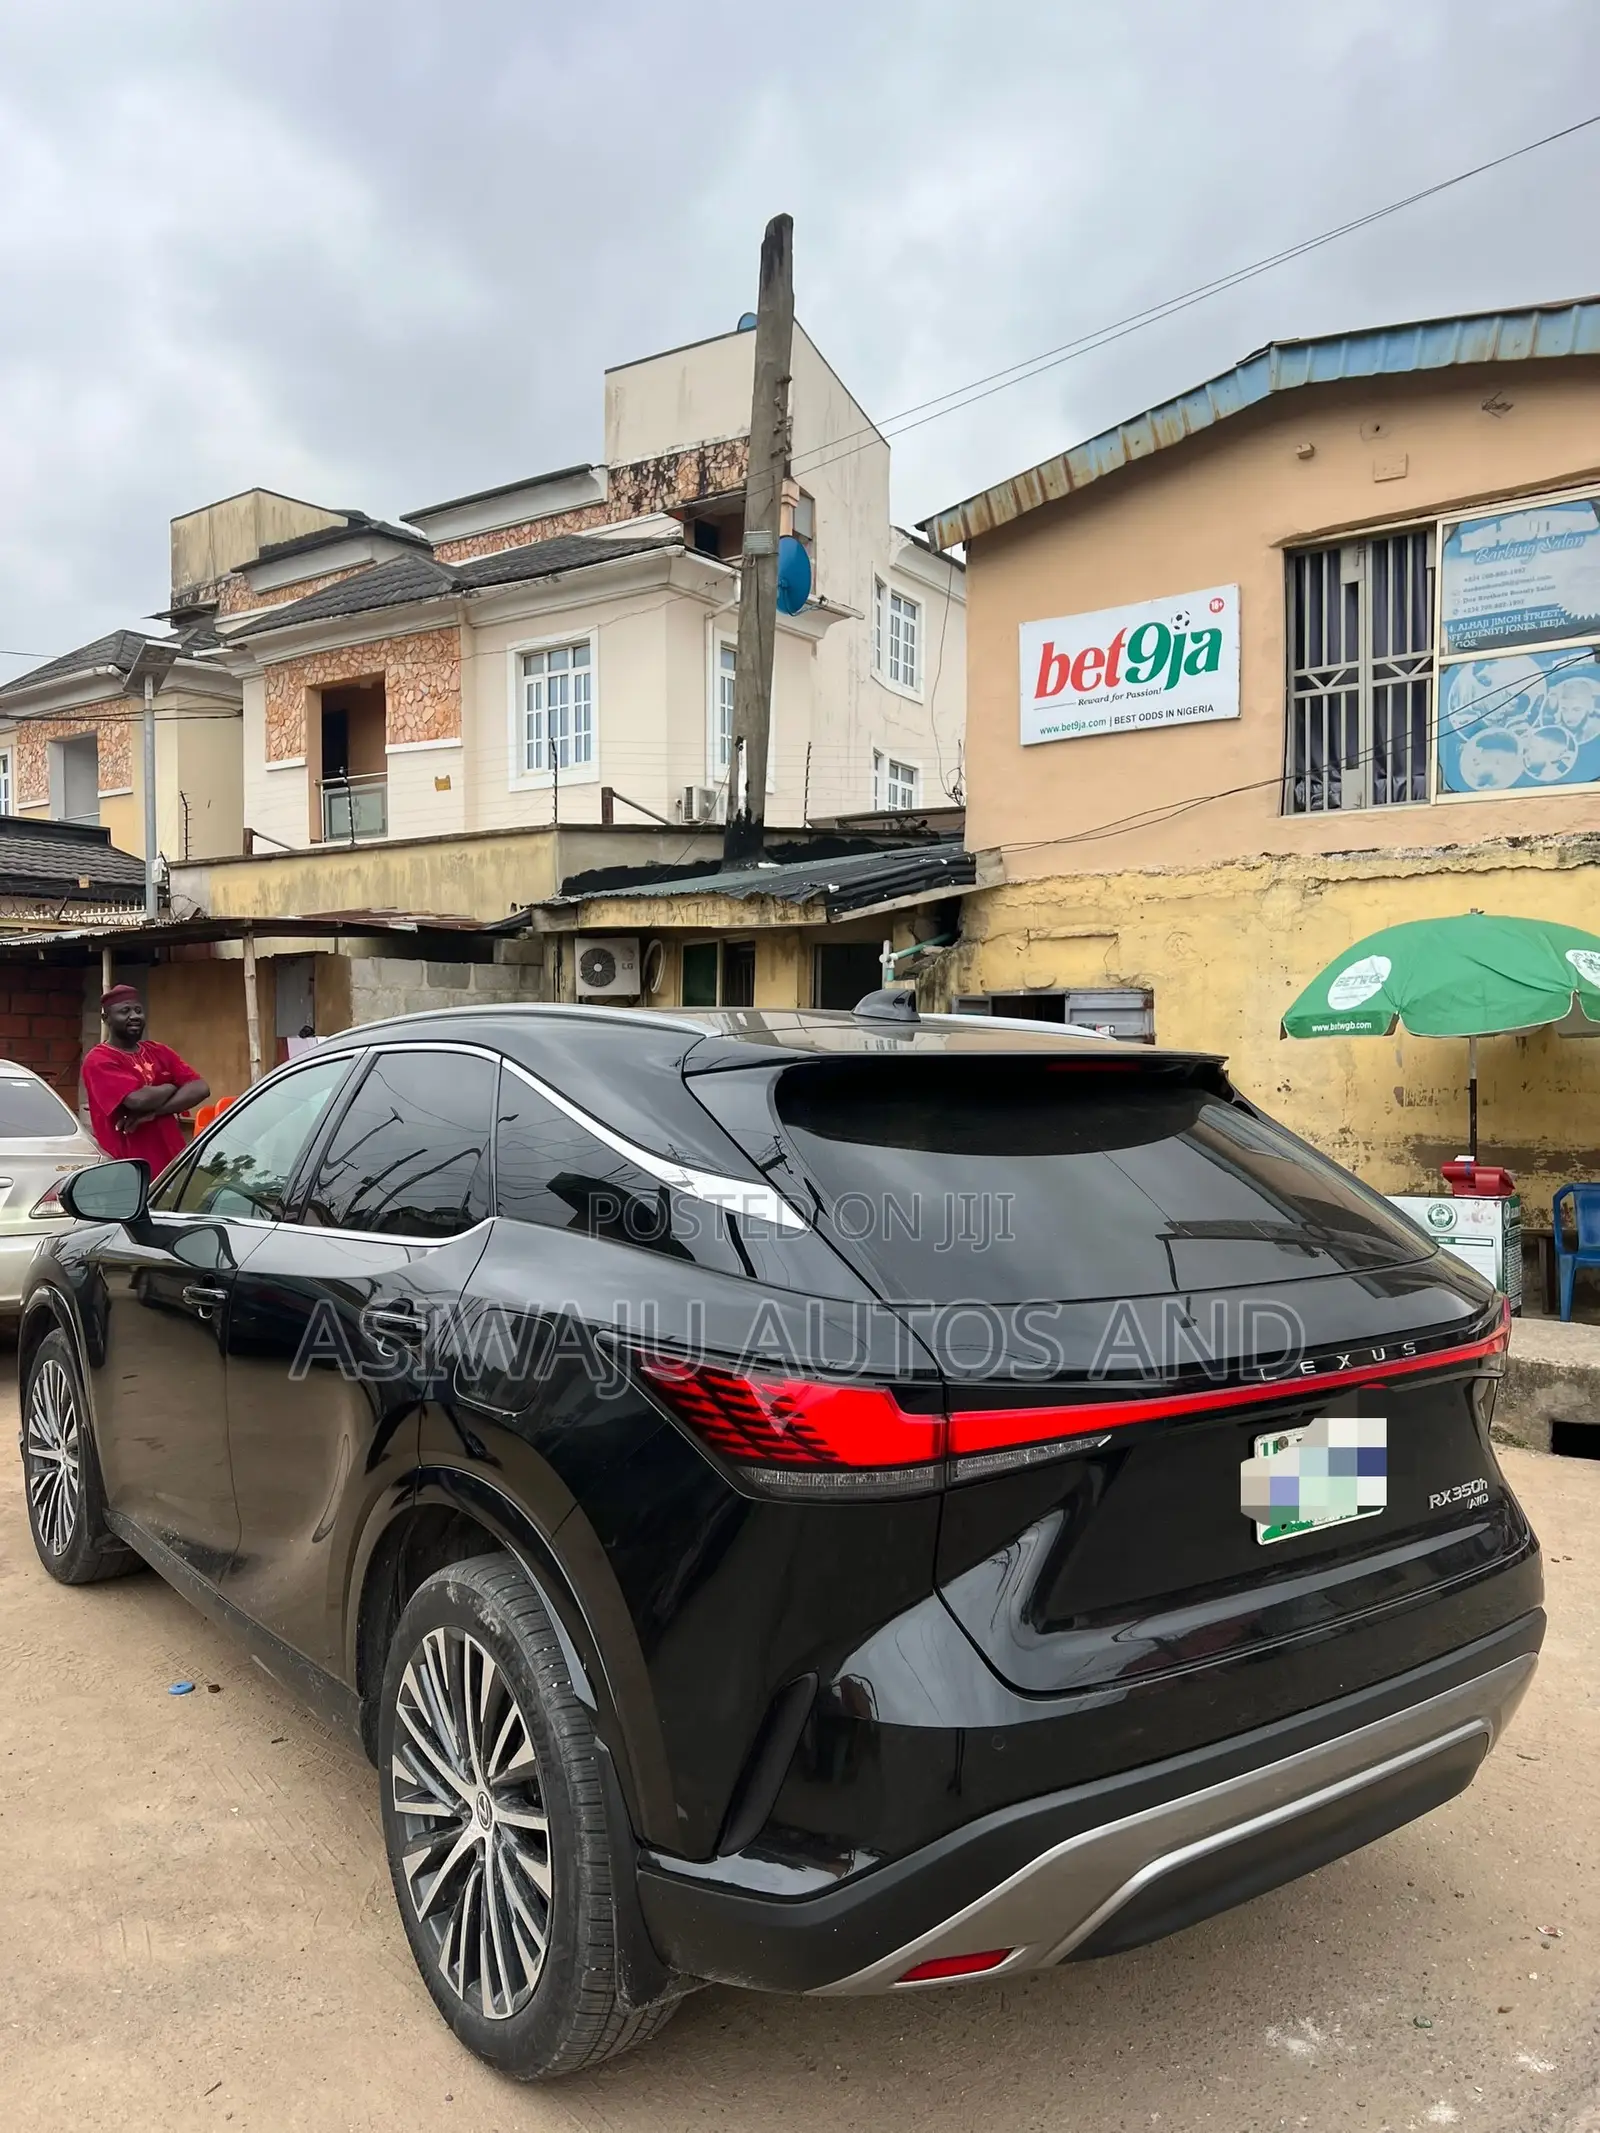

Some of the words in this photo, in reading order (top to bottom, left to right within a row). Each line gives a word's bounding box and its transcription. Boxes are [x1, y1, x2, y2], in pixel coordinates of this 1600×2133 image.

[1475, 541, 1537, 564] Barbing
[1541, 531, 1585, 553] Salon
[1457, 620, 1489, 631] ALHAJI
[1491, 615, 1521, 627] JIMOH
[1464, 627, 1504, 640] ADENIYI
[1034, 611, 1222, 699] bet9ja
[1078, 694, 1109, 706] Reward
[1110, 692, 1125, 704] for
[1126, 687, 1162, 700] Passion!
[1039, 718, 1106, 735] www.bet9ja.com
[1114, 714, 1137, 725] BEST
[1138, 709, 1163, 721] ODDS
[1165, 707, 1175, 718] IN
[1176, 704, 1214, 716] NIGERIA
[1260, 1341, 1417, 1382] LEXUS
[1429, 1477, 1488, 1510] RX350h
